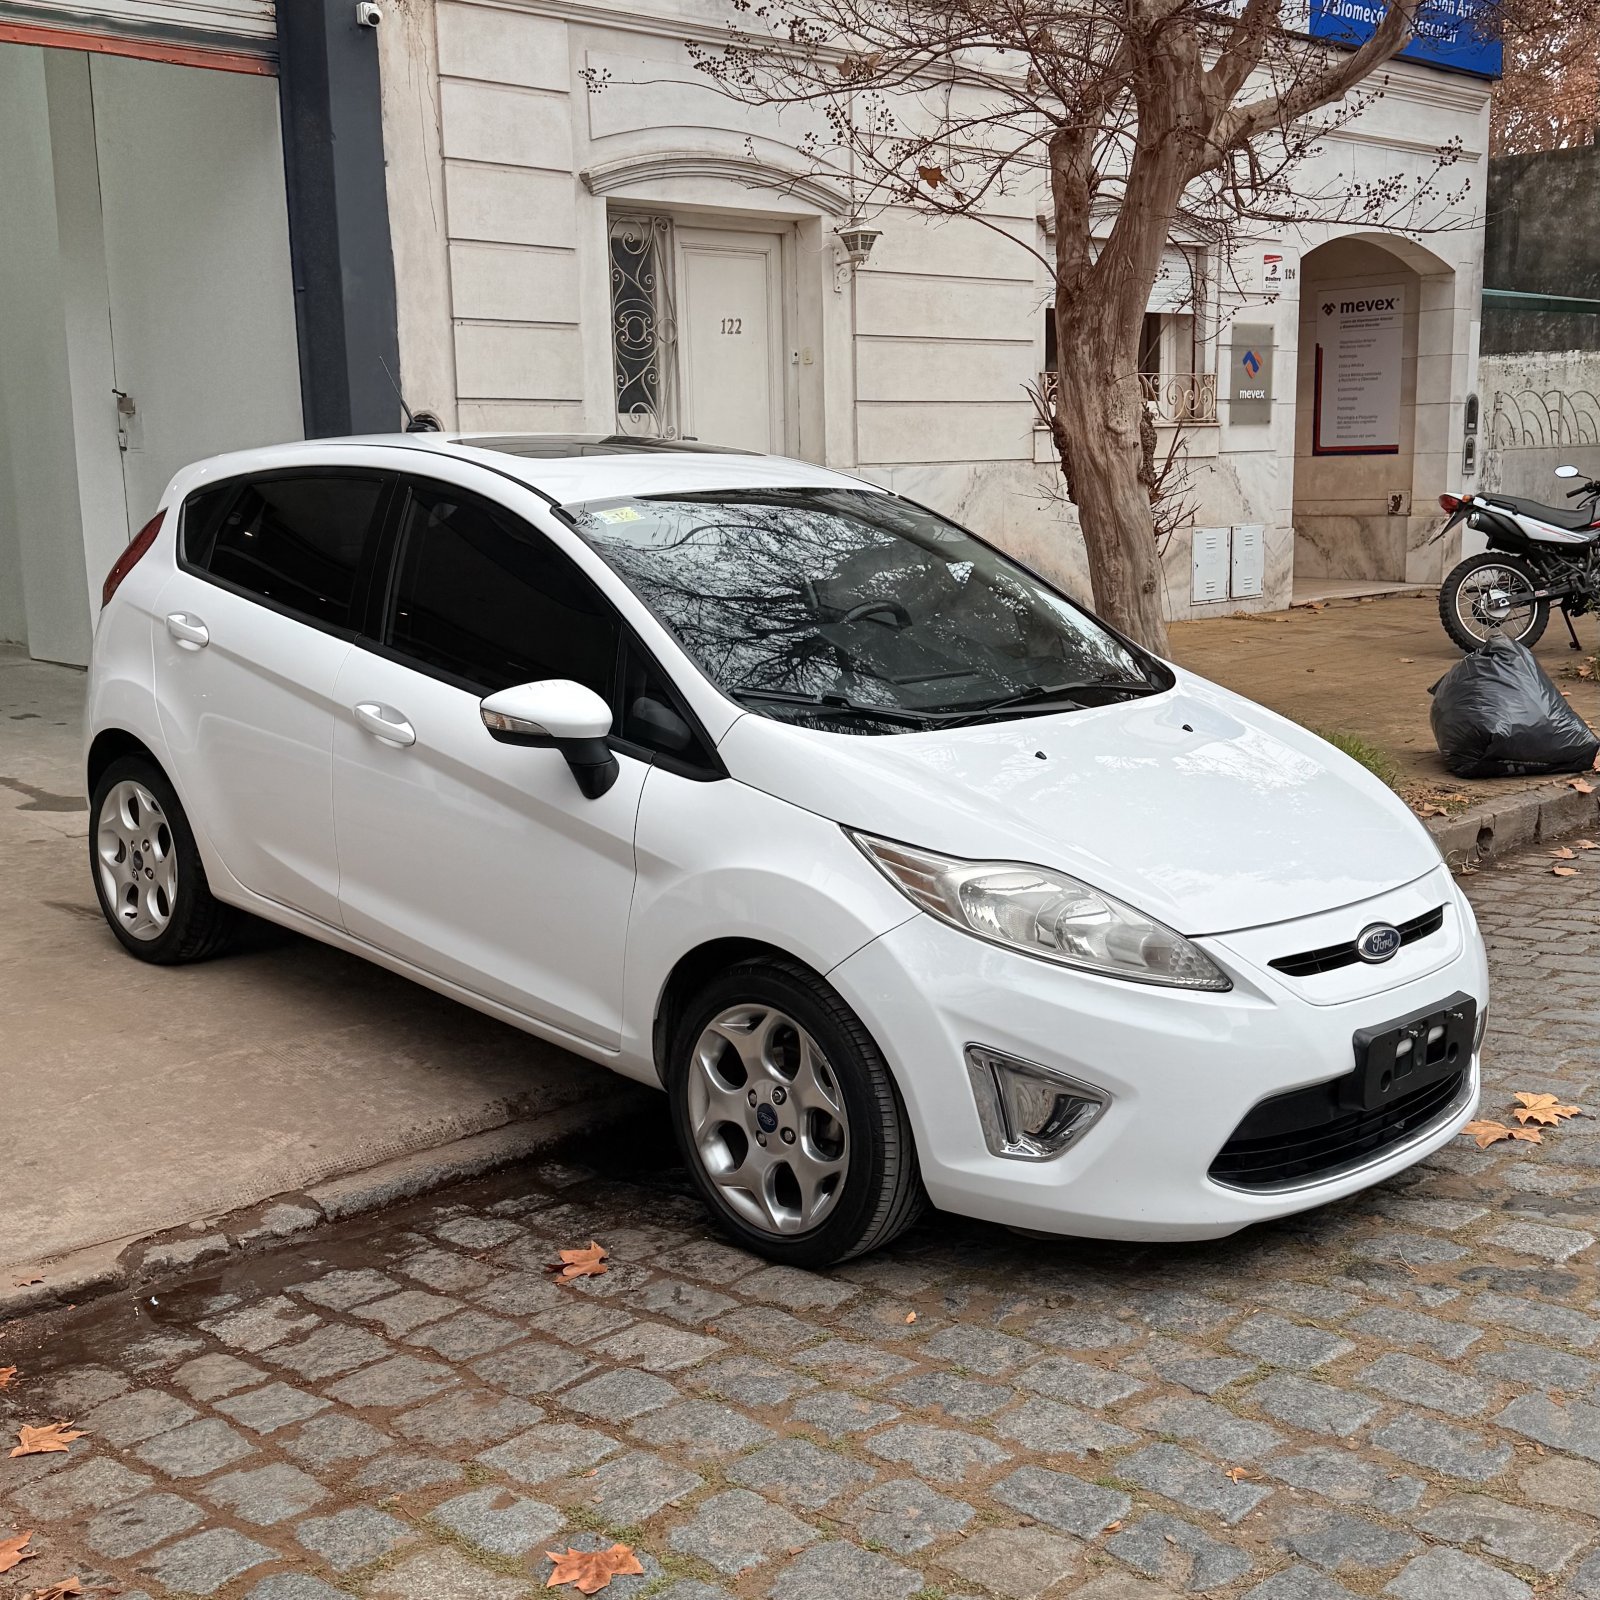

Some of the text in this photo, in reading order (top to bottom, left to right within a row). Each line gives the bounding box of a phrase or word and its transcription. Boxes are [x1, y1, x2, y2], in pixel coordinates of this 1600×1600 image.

[1340, 298, 1395, 313] mevex
[721, 318, 742, 334] 122
[1239, 389, 1265, 399] mevex
[1372, 932, 1394, 952] Ford
